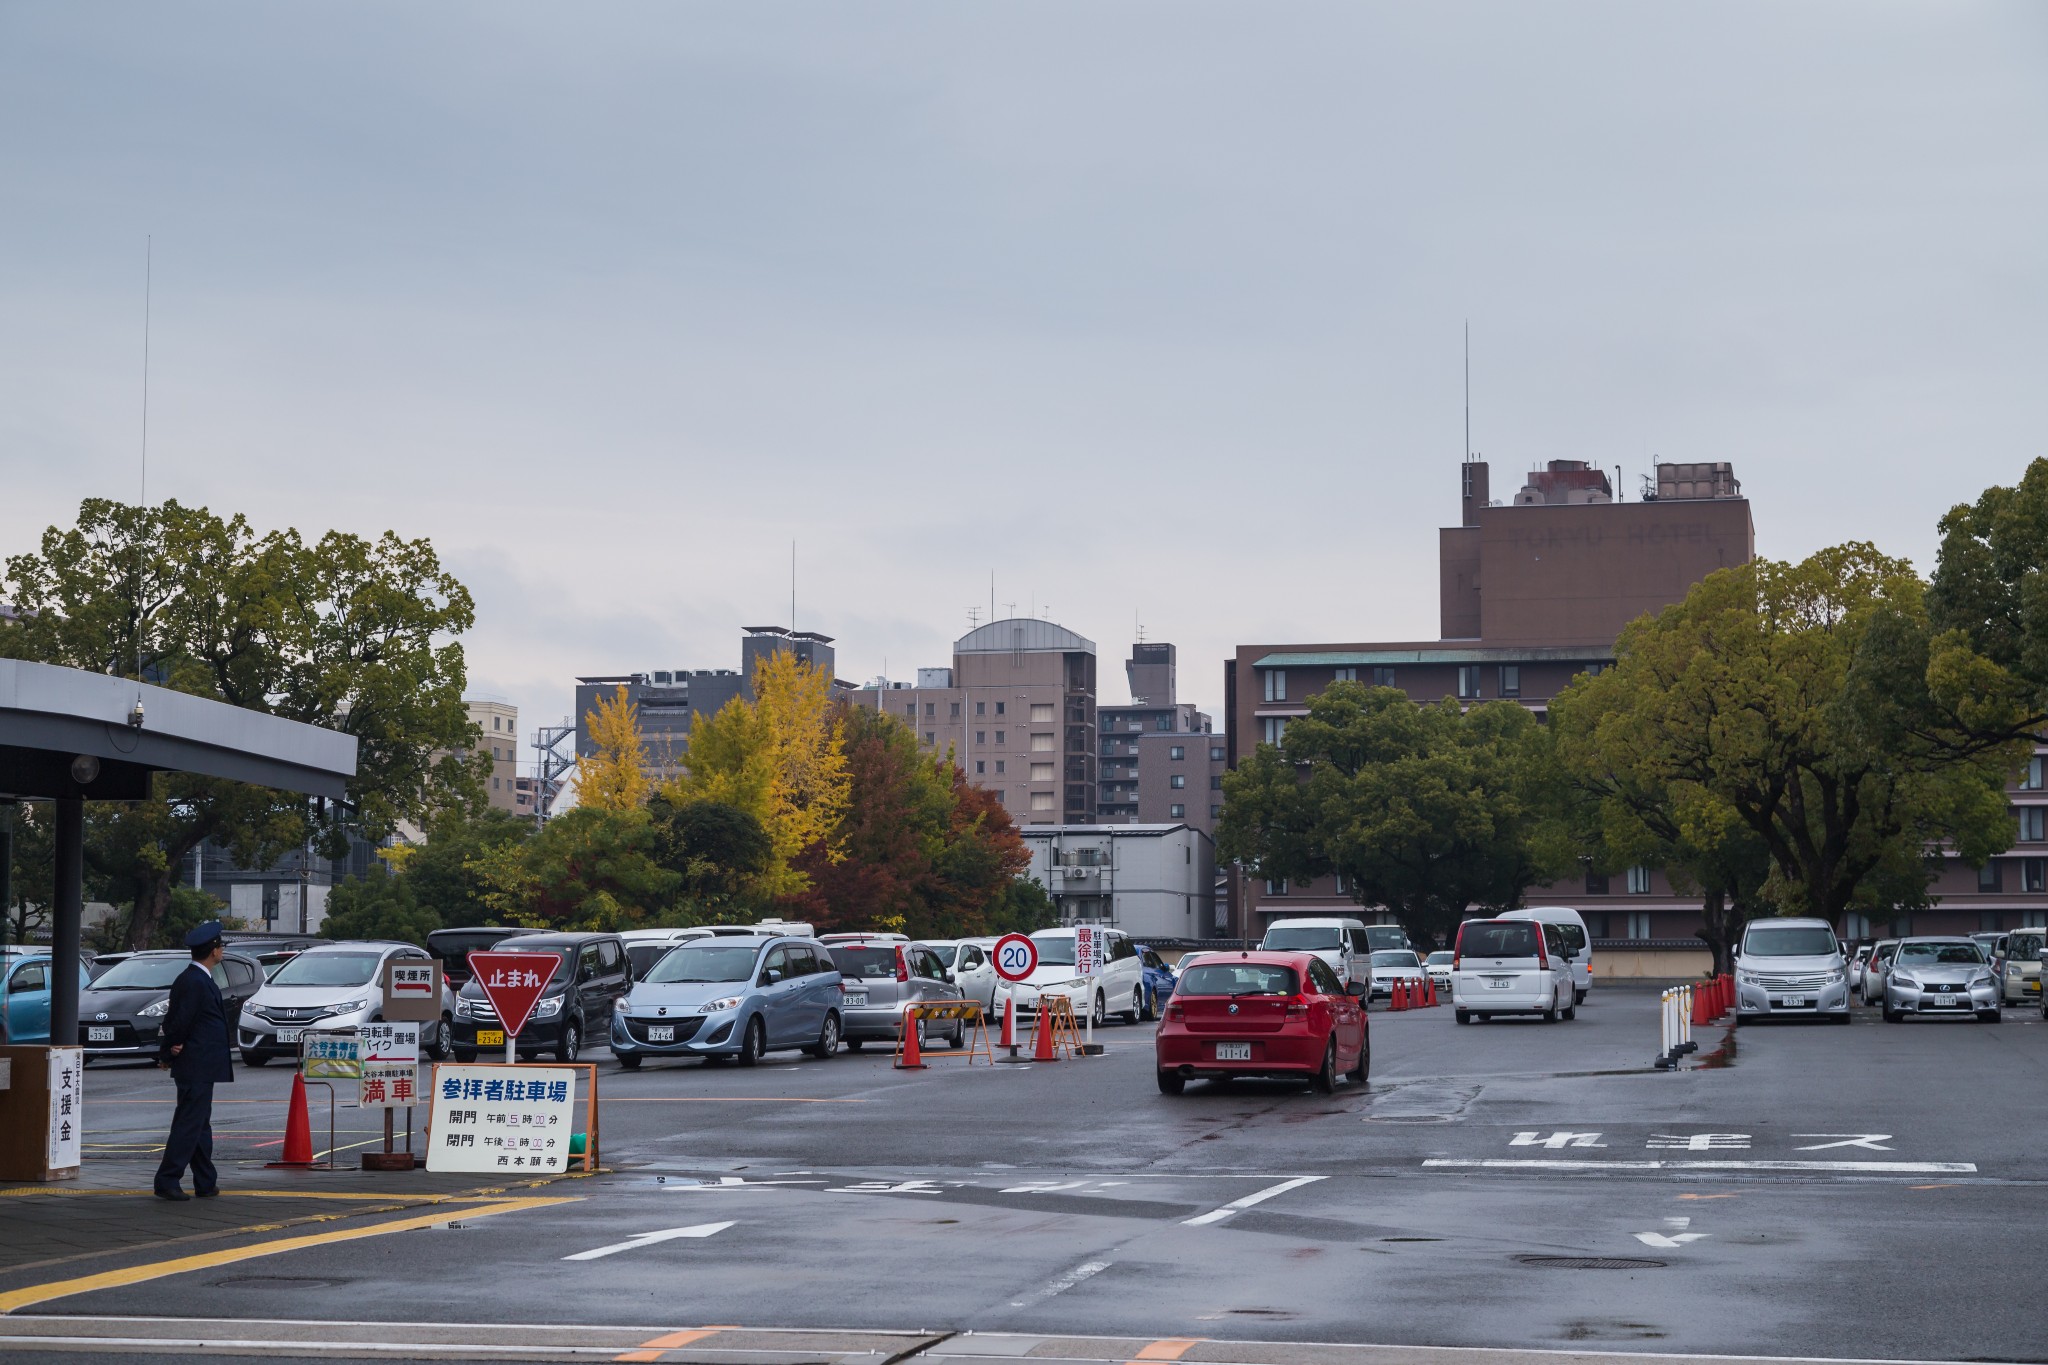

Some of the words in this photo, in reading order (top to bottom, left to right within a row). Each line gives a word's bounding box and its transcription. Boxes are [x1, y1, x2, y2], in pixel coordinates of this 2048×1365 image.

[1078, 928, 1092, 974] 最徐行
[1093, 931, 1103, 968] 駐車場内
[1003, 947, 1027, 968] 20
[394, 970, 431, 982] 喫煙所
[487, 968, 541, 988] 止まれ
[93, 1032, 112, 1040] 33-61
[360, 1026, 393, 1038] 自転車
[394, 1032, 416, 1045] 置場
[653, 1032, 673, 1040] 74-64
[482, 1036, 502, 1044] 23-62
[308, 1051, 358, 1061] バス乗り場
[1224, 1048, 1249, 1059] 11-14
[362, 1078, 415, 1104] 満車
[442, 1077, 568, 1103] 参拝者駐車場
[60, 1068, 73, 1142] 支援金
[448, 1109, 477, 1124] 開門
[446, 1133, 475, 1147] 閉門
[497, 1155, 558, 1167] 西本願寺
